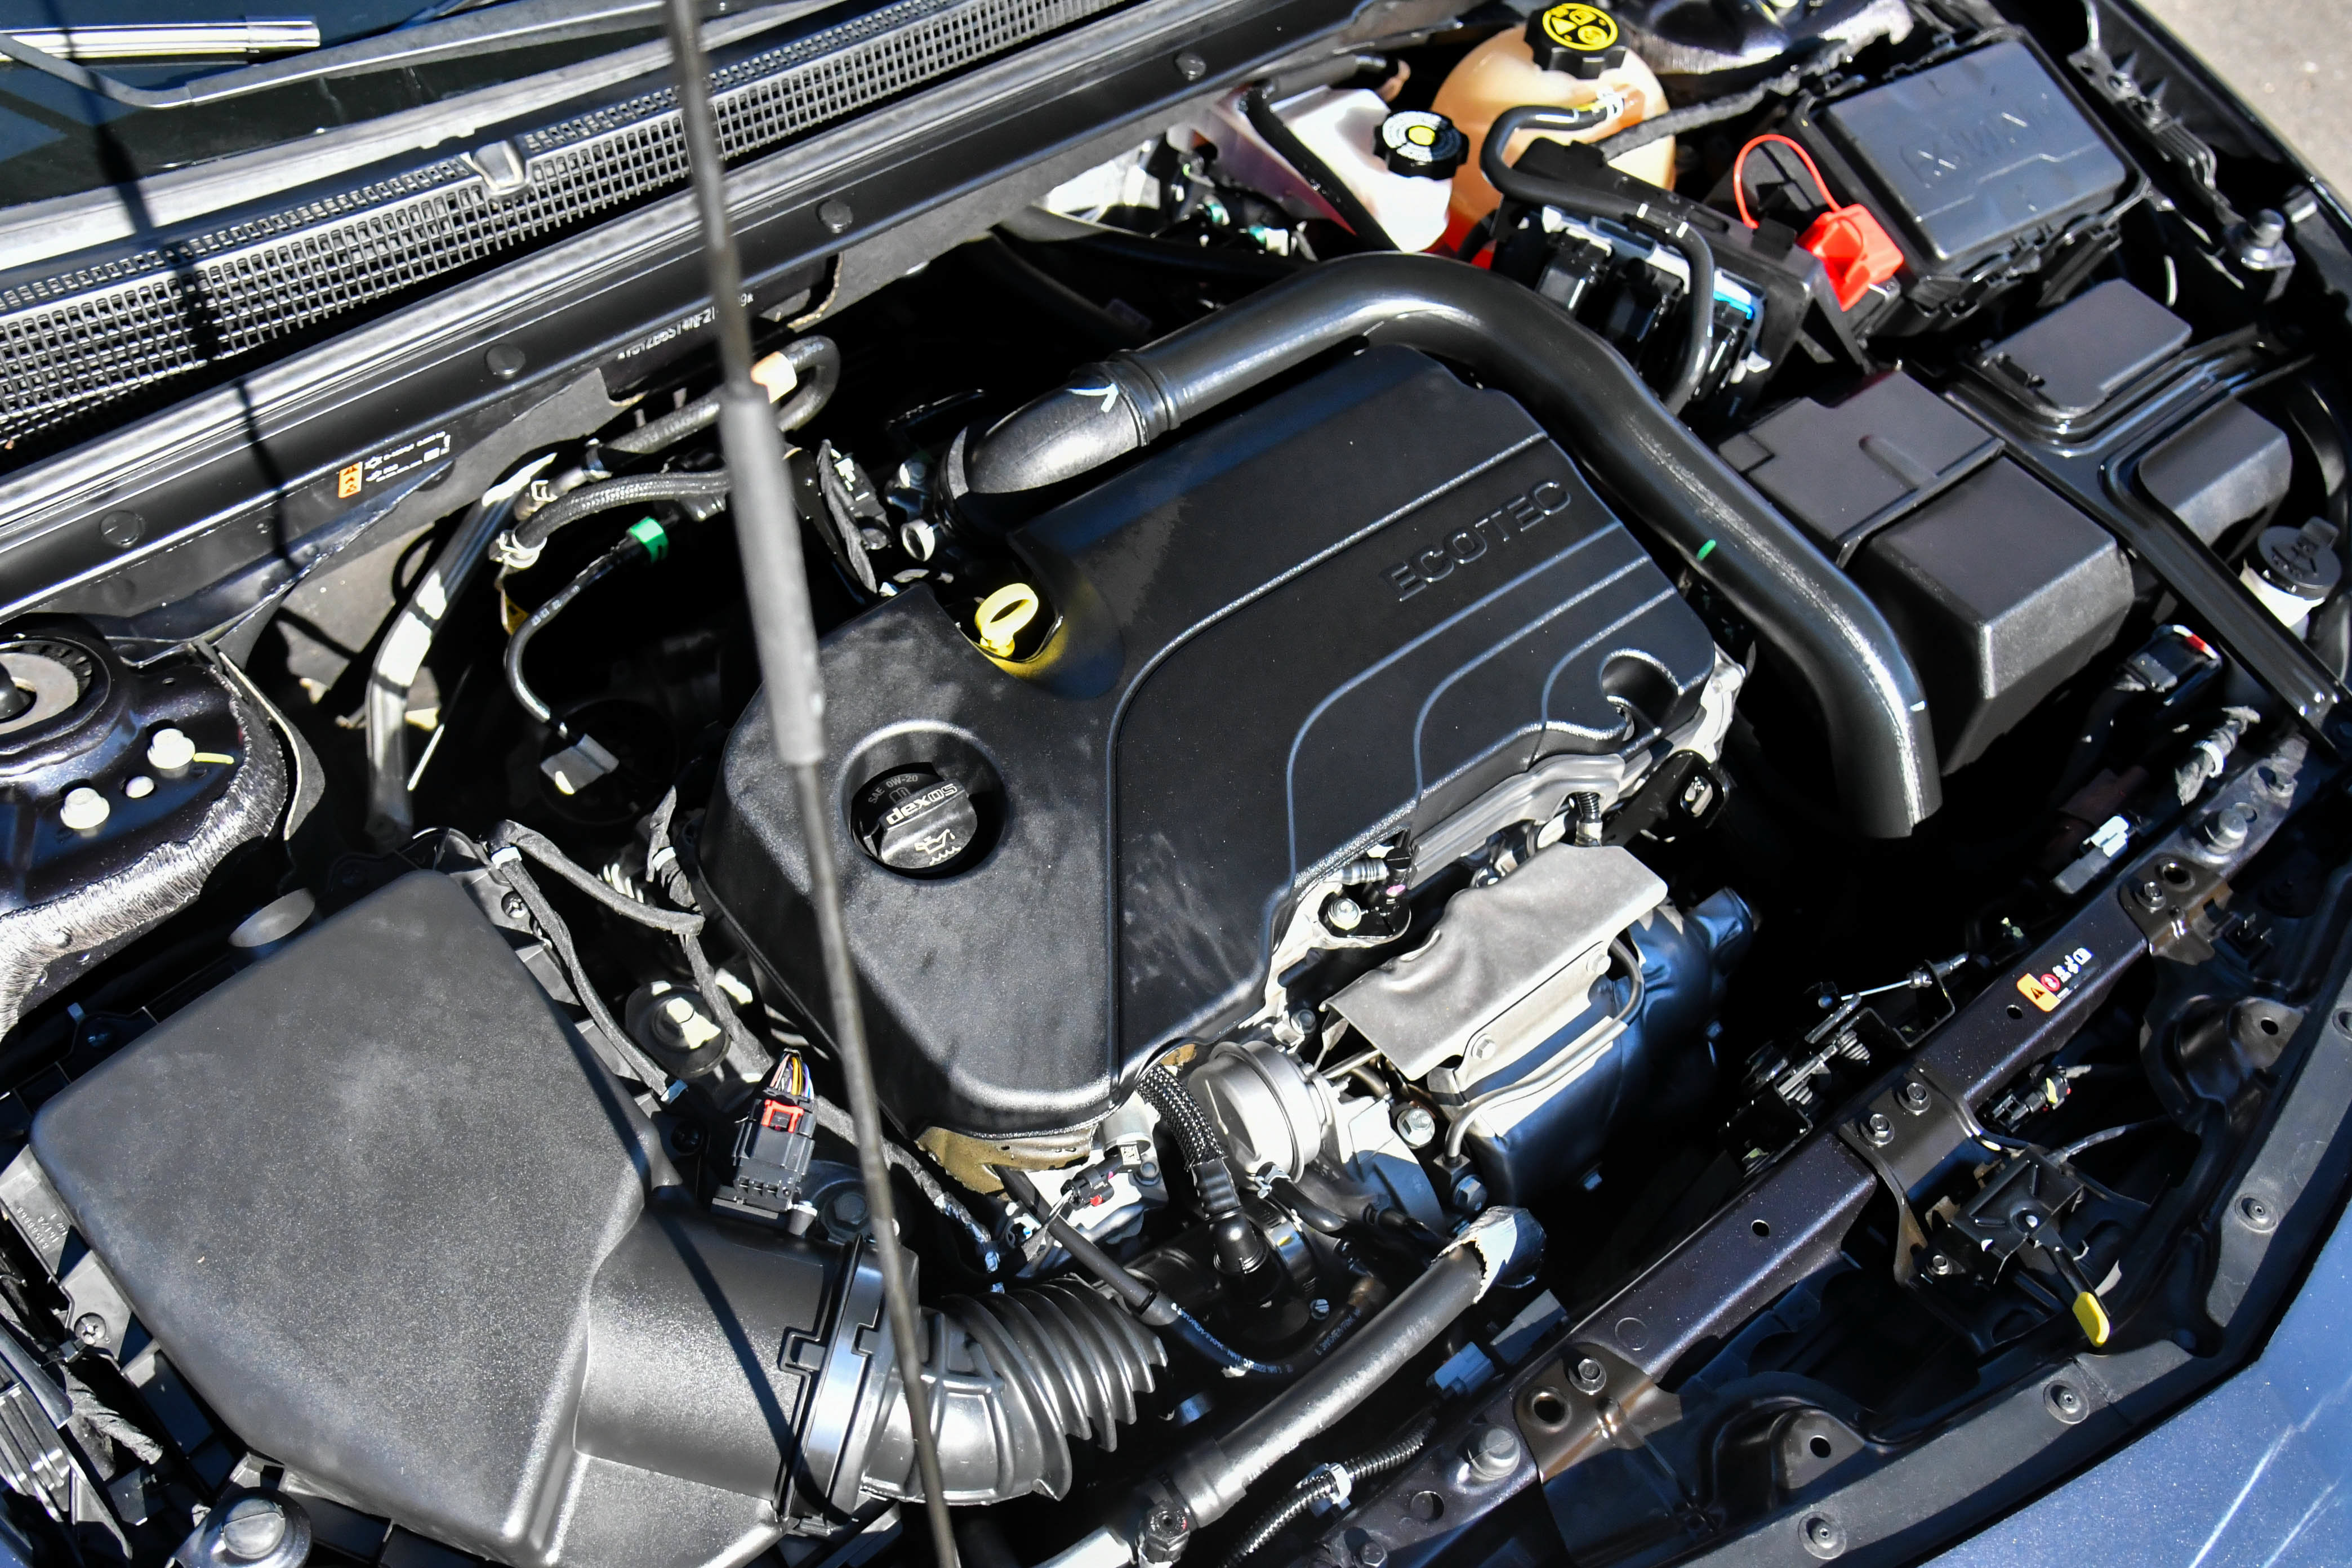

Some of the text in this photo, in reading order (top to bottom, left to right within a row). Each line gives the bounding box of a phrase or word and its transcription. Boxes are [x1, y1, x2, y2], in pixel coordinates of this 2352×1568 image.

[1381, 481, 1571, 602] ECOTEC
[868, 775, 919, 804] SAE 0W-20
[886, 783, 957, 825] dexos
